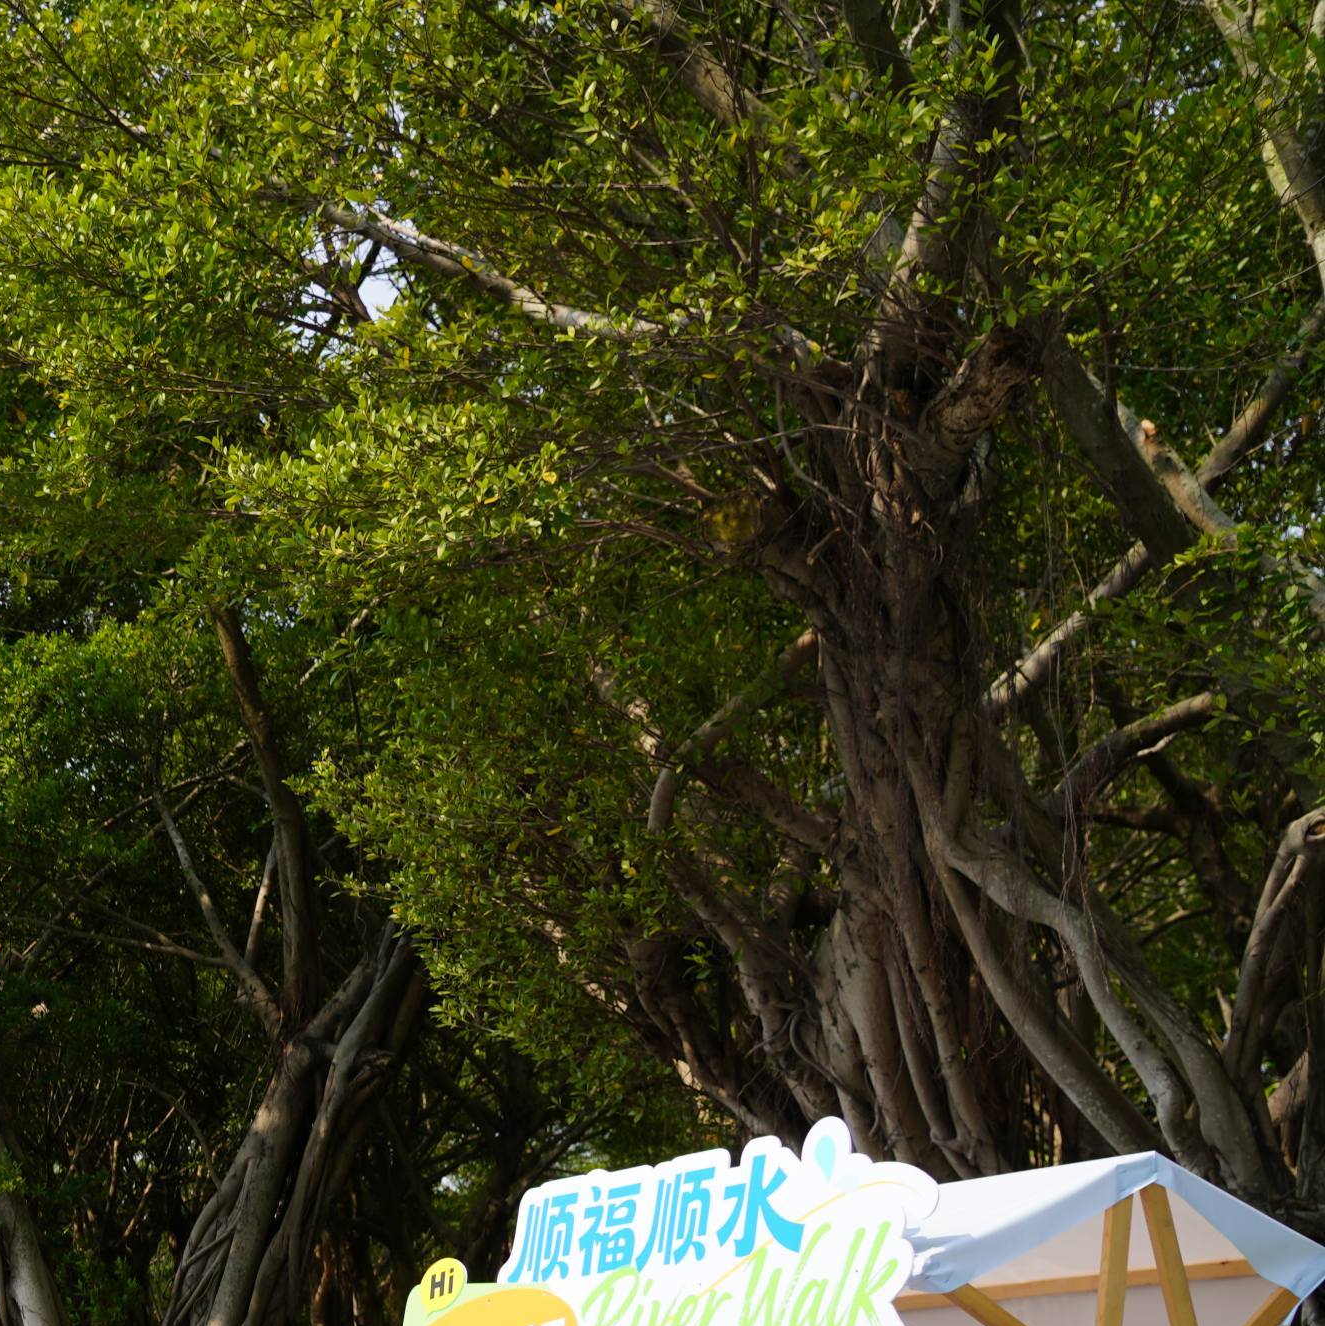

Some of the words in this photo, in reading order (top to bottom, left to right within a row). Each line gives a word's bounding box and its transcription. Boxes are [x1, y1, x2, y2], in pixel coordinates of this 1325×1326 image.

[508, 1154, 805, 1283] 顺福顺水
[429, 1267, 455, 1300] Hi
